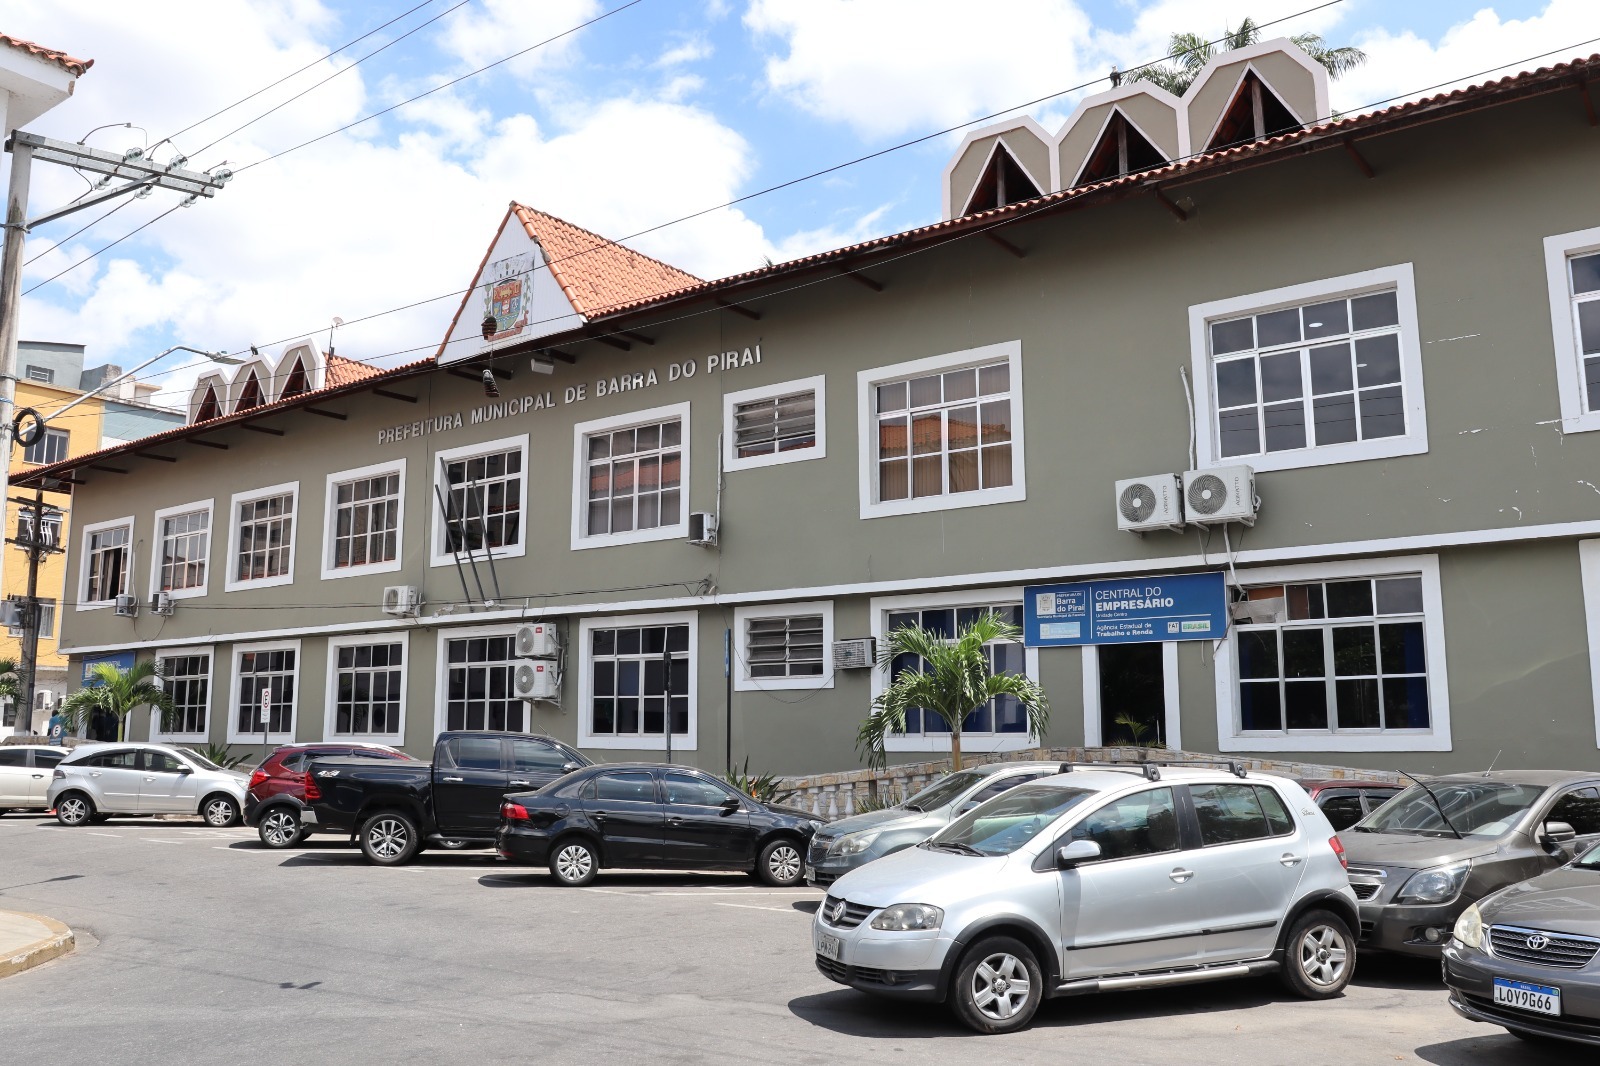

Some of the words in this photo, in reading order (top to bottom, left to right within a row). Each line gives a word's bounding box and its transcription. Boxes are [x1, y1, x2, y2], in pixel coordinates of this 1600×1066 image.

[378, 413, 463, 445] PREFEITURA
[471, 391, 556, 425] MUNICIPAL
[564, 383, 588, 404] DE
[596, 368, 658, 398] BARRA
[668, 359, 697, 382] DO
[1095, 588, 1143, 601] CENTRAL
[1145, 586, 1162, 597] DO
[1095, 596, 1174, 612] EMPRESÁRIO
[1119, 622, 1143, 630] Estadual
